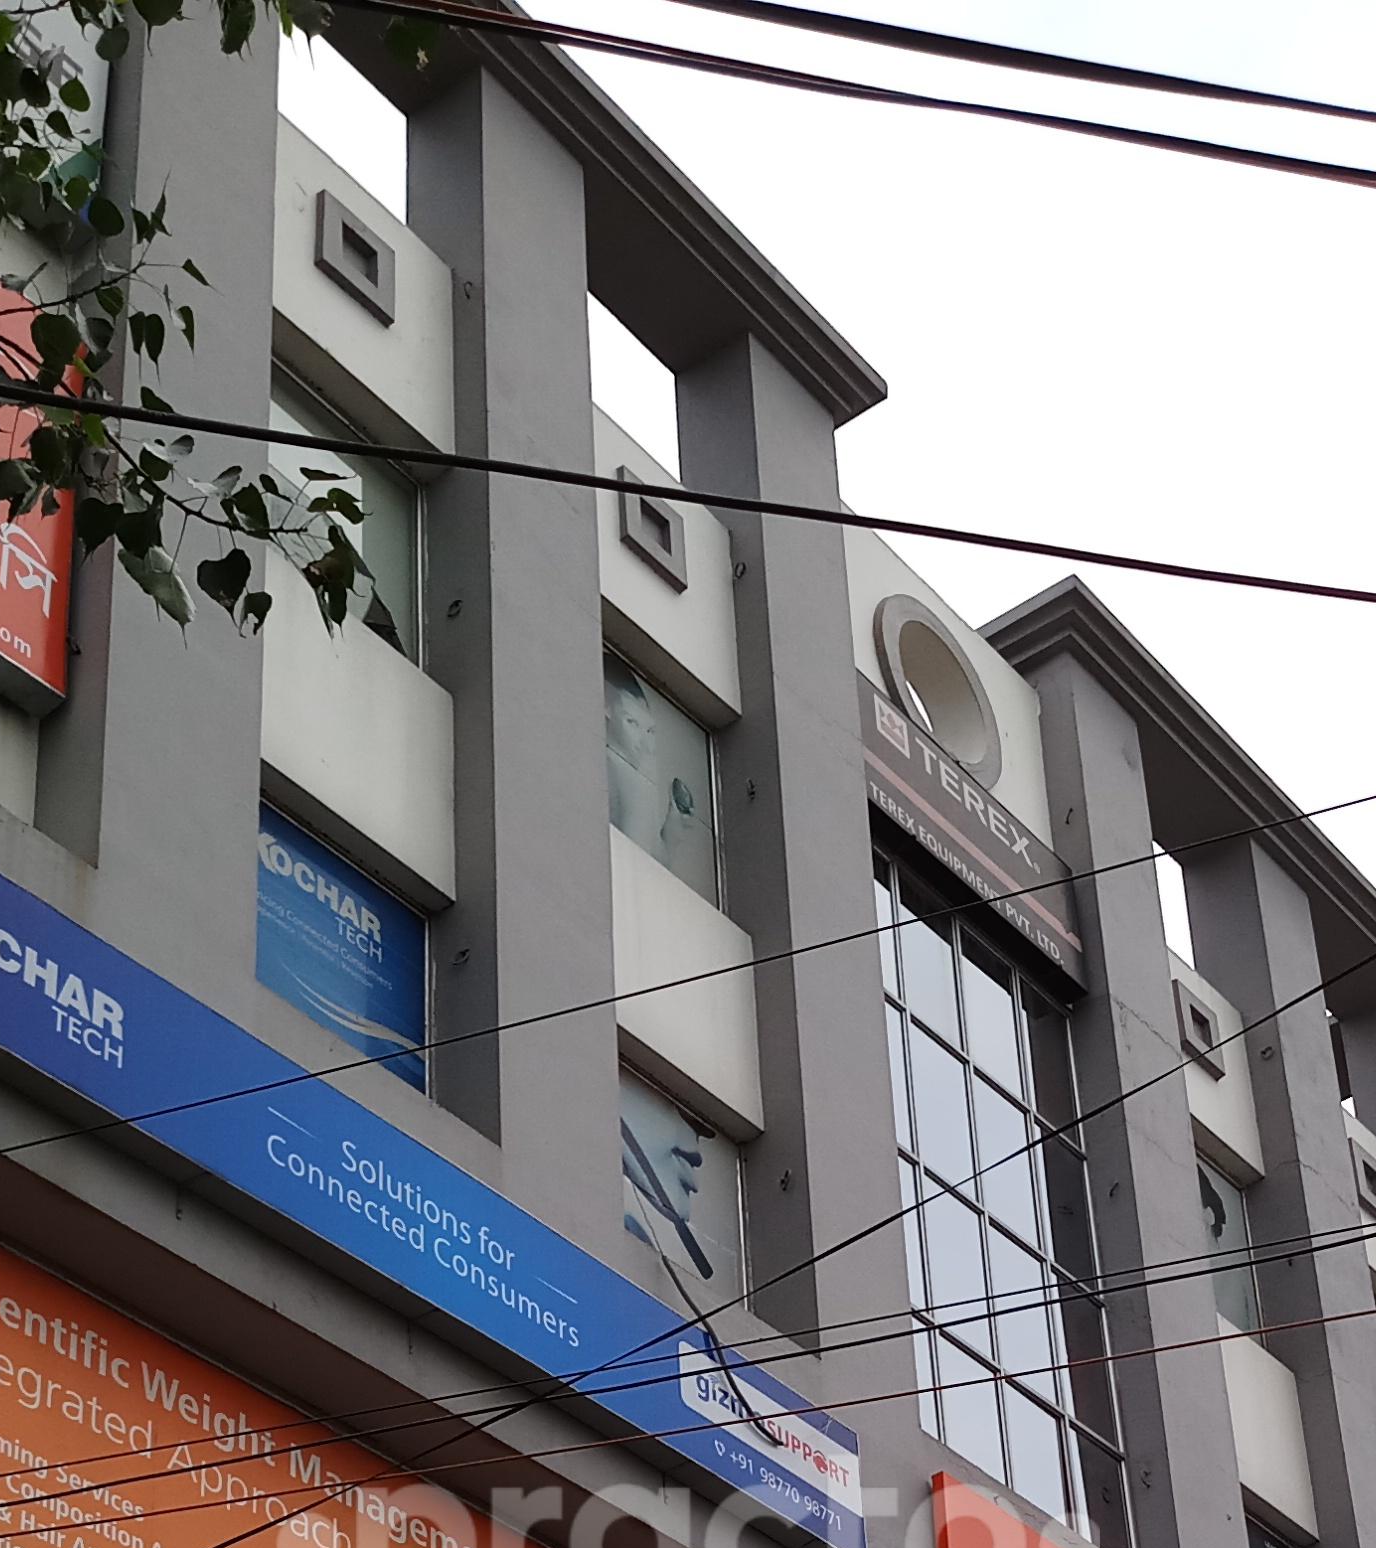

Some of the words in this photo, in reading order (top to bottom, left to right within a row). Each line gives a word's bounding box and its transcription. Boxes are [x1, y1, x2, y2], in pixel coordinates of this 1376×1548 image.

[915, 736, 1036, 869] TEREX
[869, 780, 916, 836] TEREX
[920, 826, 1002, 917] EQUIPMENT
[1006, 900, 1036, 939] PVT.
[335, 916, 382, 964] TECH
[51, 1005, 123, 1069] TECH
[267, 1135, 425, 1253] Connected
[433, 1237, 580, 1347] Consumers
[341, 1140, 472, 1245] Solutions
[478, 1226, 516, 1271] for
[141, 1360, 276, 1468] Weight
[20, 1510, 66, 1548] Hair
[56, 1463, 145, 1522] Services
[729, 1449, 754, 1475] +91
[760, 1467, 800, 1504] 98770
[804, 1495, 842, 1531] 98771
